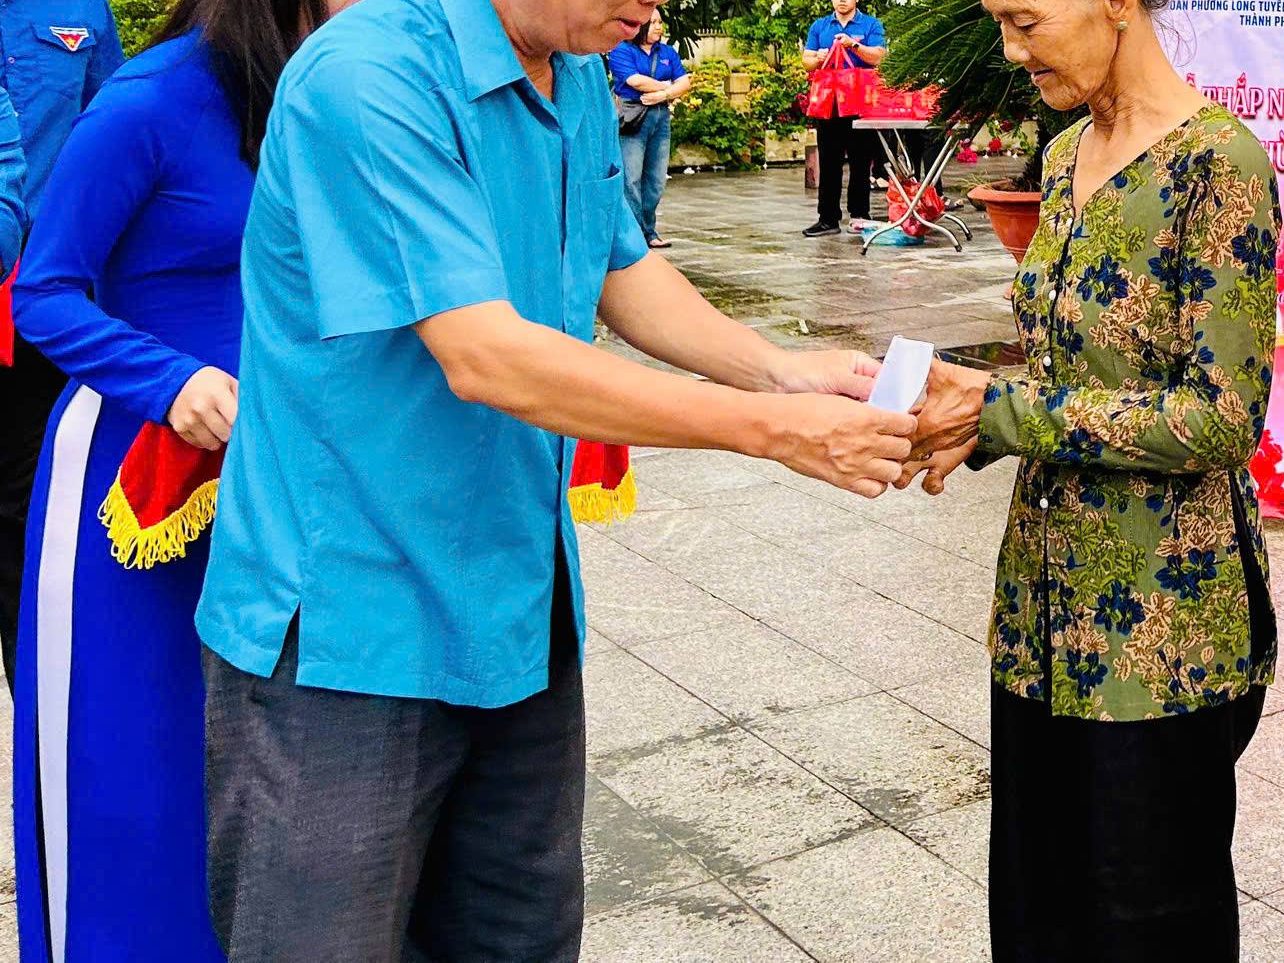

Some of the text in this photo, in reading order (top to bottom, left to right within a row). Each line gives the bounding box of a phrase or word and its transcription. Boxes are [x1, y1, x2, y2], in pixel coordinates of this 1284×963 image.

[1231, 0, 1256, 12] LONG
[1240, 12, 1271, 27] THÀNH
[1201, 72, 1264, 120] THẮP
